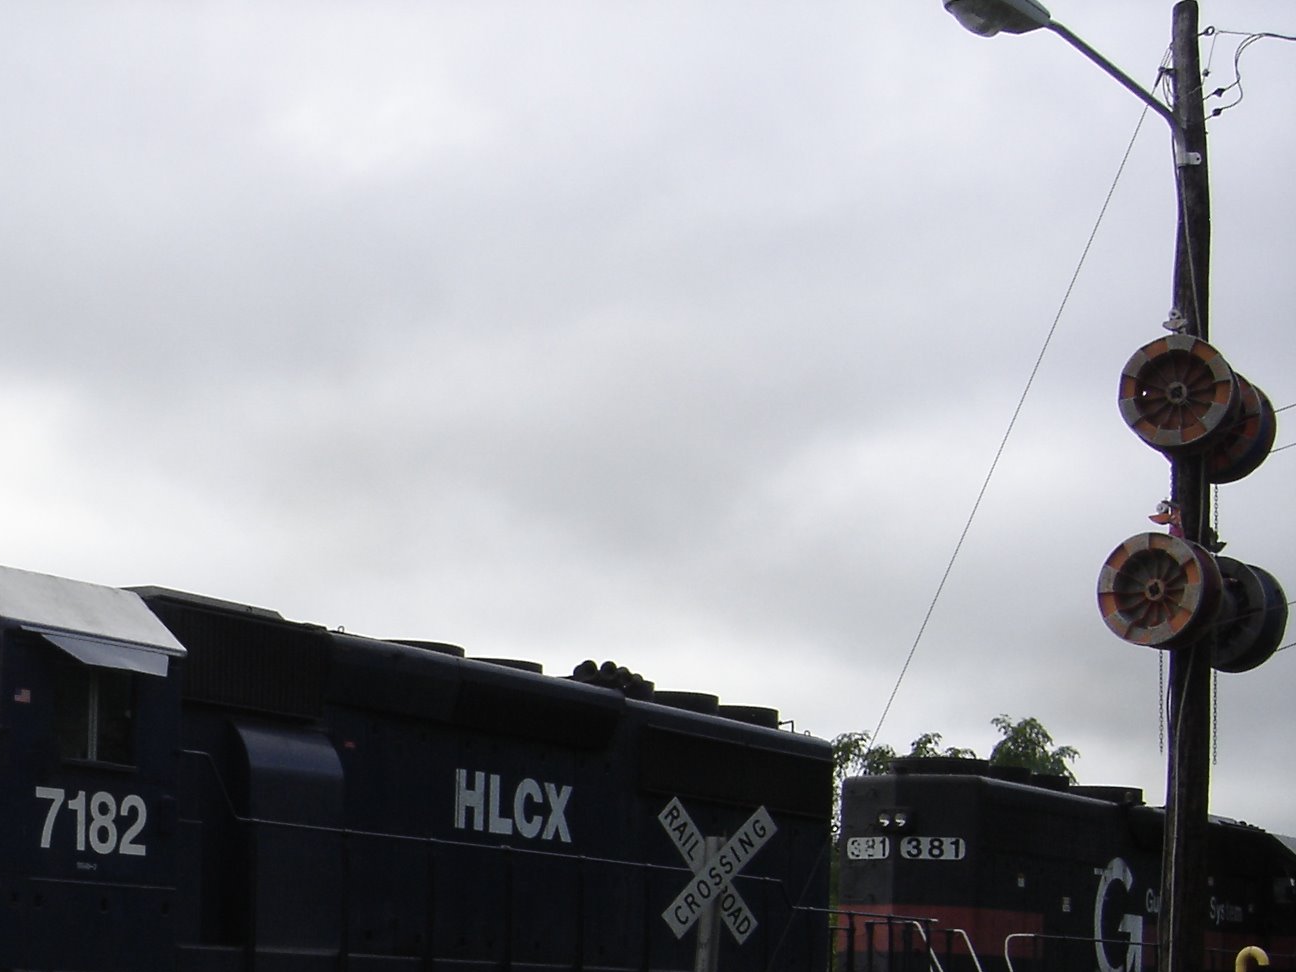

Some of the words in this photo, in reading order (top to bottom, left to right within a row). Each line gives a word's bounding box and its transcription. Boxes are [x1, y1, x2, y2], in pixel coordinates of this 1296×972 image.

[35, 785, 147, 857] 7182
[454, 768, 573, 843] HLCX
[665, 805, 699, 861] RAIL
[674, 819, 767, 925] CROSSING
[906, 837, 960, 858] 381
